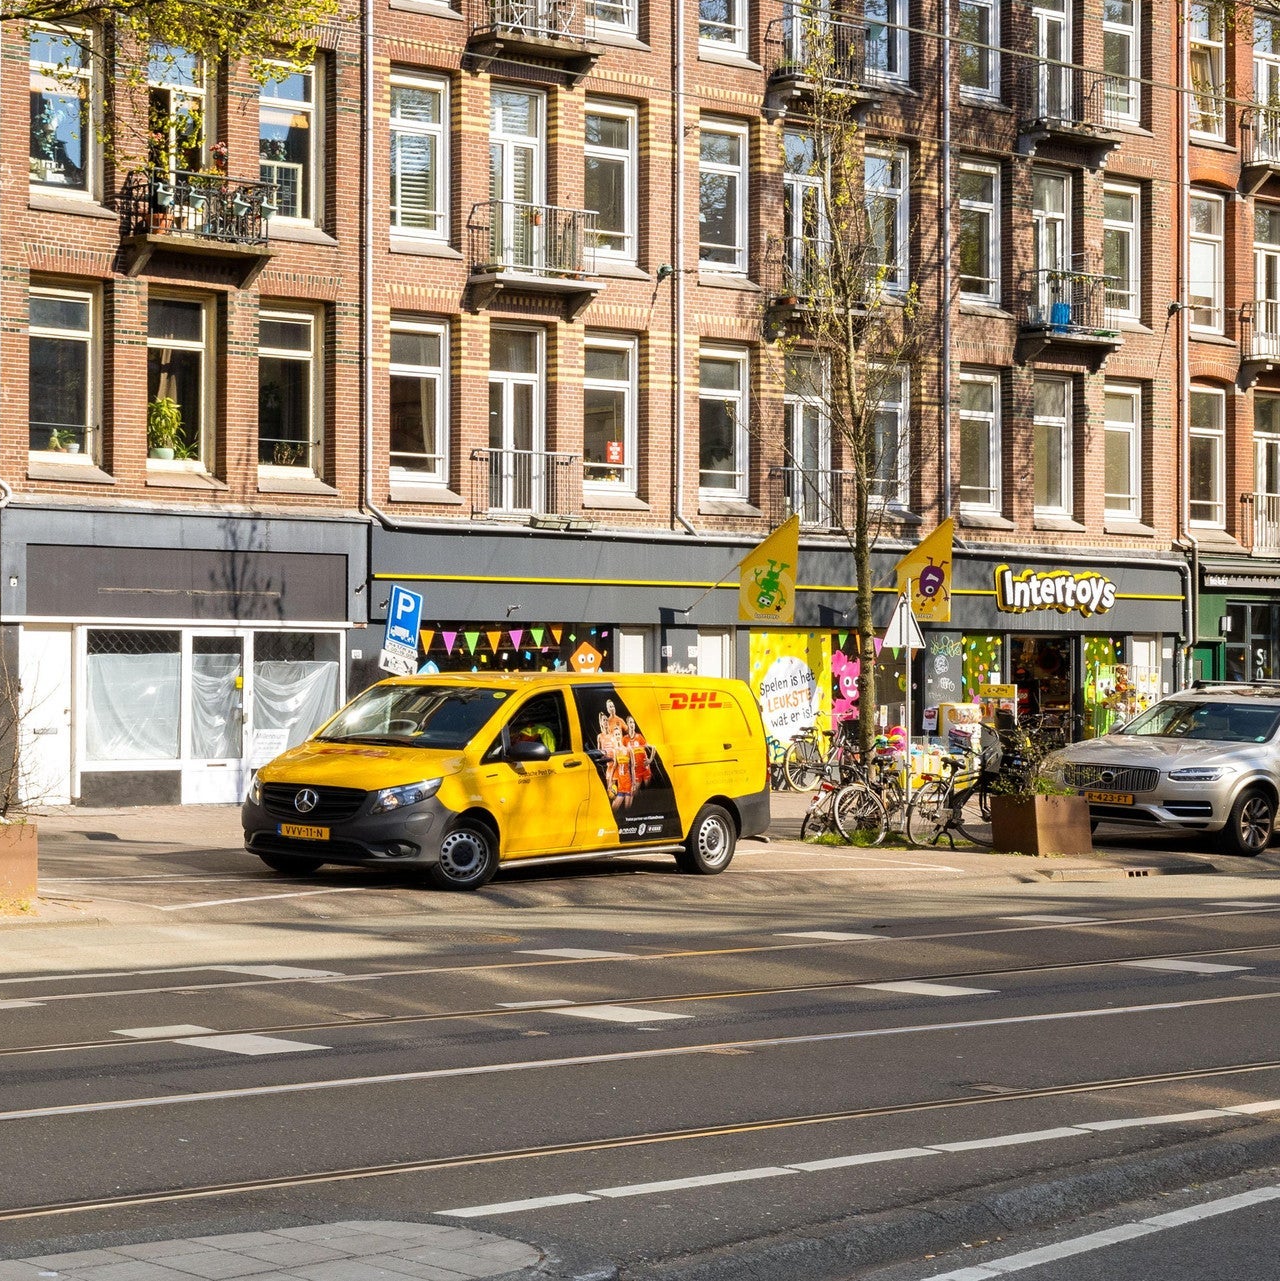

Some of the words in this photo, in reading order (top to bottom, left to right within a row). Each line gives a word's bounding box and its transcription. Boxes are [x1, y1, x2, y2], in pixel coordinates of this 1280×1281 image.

[1003, 569, 1117, 612] Intertoys
[396, 591, 416, 620] P
[759, 677, 788, 698] Spelen
[790, 674, 799, 687] is
[799, 668, 816, 684] het
[669, 691, 723, 710] DHL
[767, 687, 812, 713] LEUKSTE
[770, 712, 789, 728] wat
[790, 712, 800, 723] er
[802, 705, 813, 719] is!
[285, 825, 323, 838] VVV-11-N
